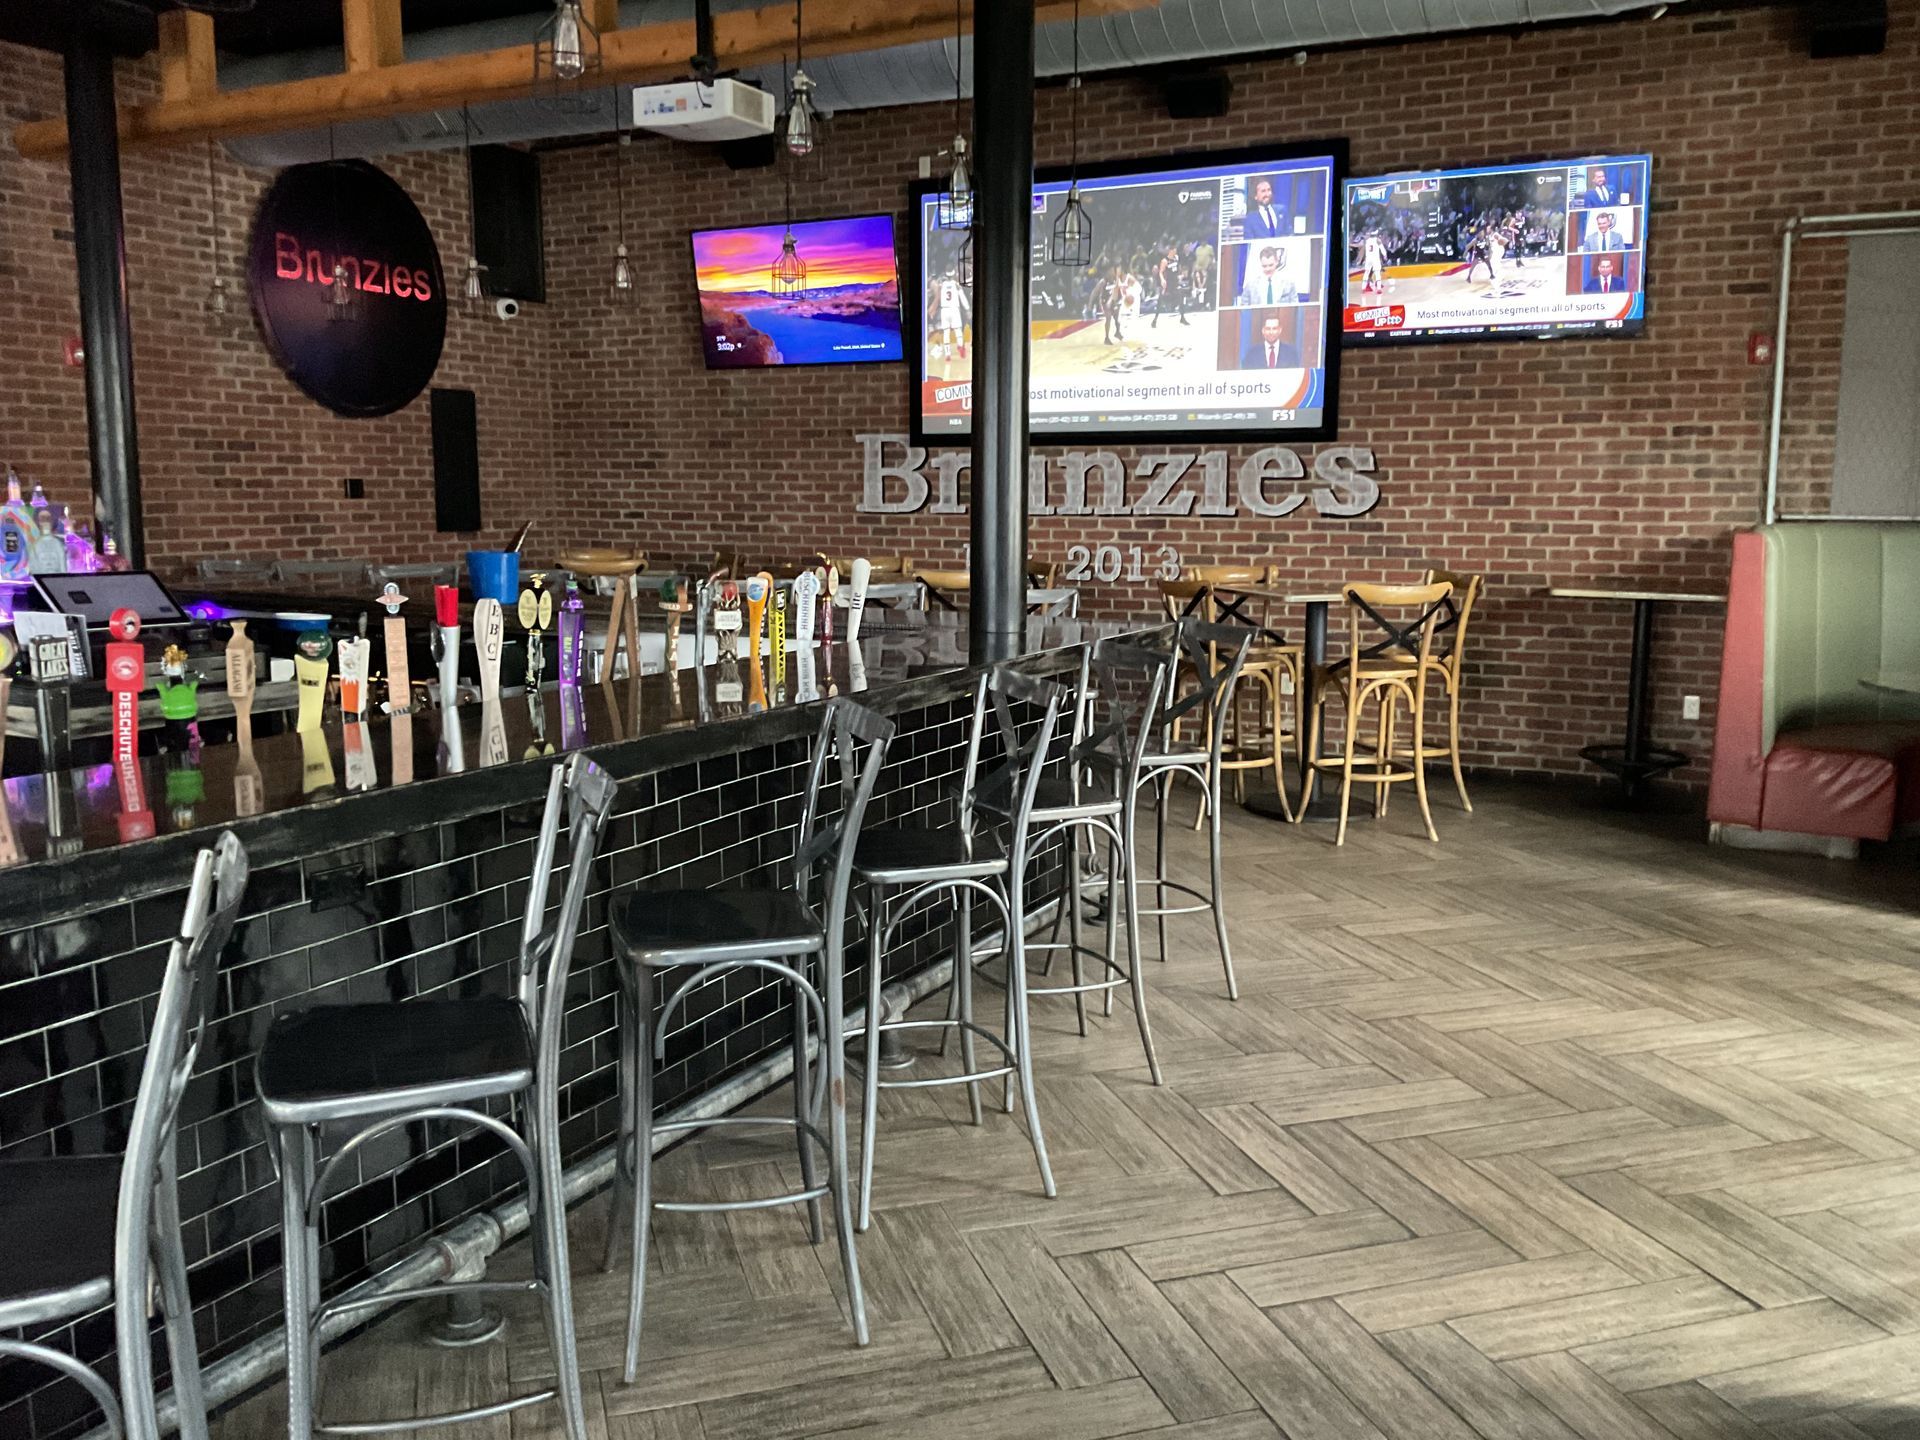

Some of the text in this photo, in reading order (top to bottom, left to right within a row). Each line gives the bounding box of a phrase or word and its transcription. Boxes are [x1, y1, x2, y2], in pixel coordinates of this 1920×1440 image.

[275, 232, 432, 301] Brunzies
[1354, 306, 1390, 322] COMING
[1417, 302, 1606, 319] Most motivational segment in all of sports
[936, 384, 972, 402] COMIN
[1029, 381, 1271, 400] ost motivational segment in all of sports
[1272, 409, 1296, 422] FS1
[854, 433, 1381, 517] Brnzies
[1066, 545, 1180, 583] 2013
[118, 691, 132, 762] DESCHUTE
